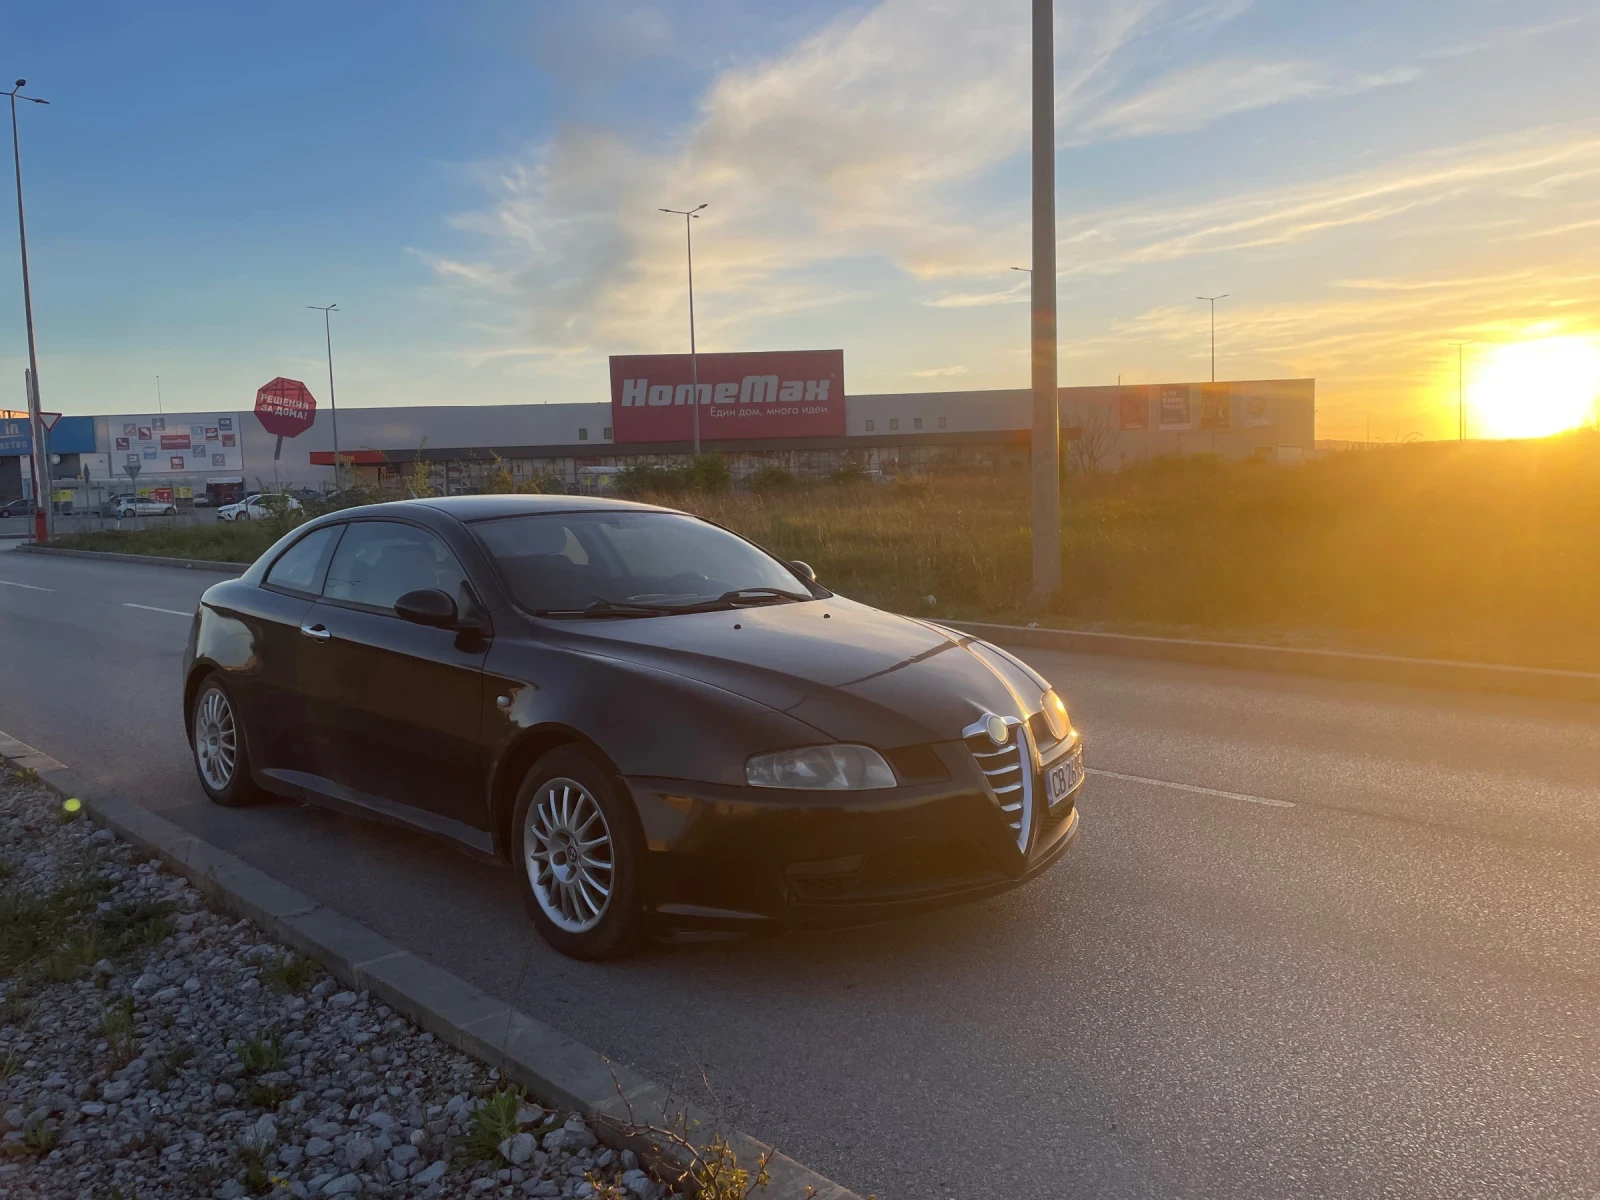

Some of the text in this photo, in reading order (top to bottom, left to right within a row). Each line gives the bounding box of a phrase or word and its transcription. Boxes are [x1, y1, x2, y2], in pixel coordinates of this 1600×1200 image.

[621, 375, 830, 406] HomeMax
[260, 393, 309, 410] РЕШЕНИЯ
[261, 404, 308, 420] ЗА ДОМА!
[710, 405, 831, 417] Един дом, много идеи.
